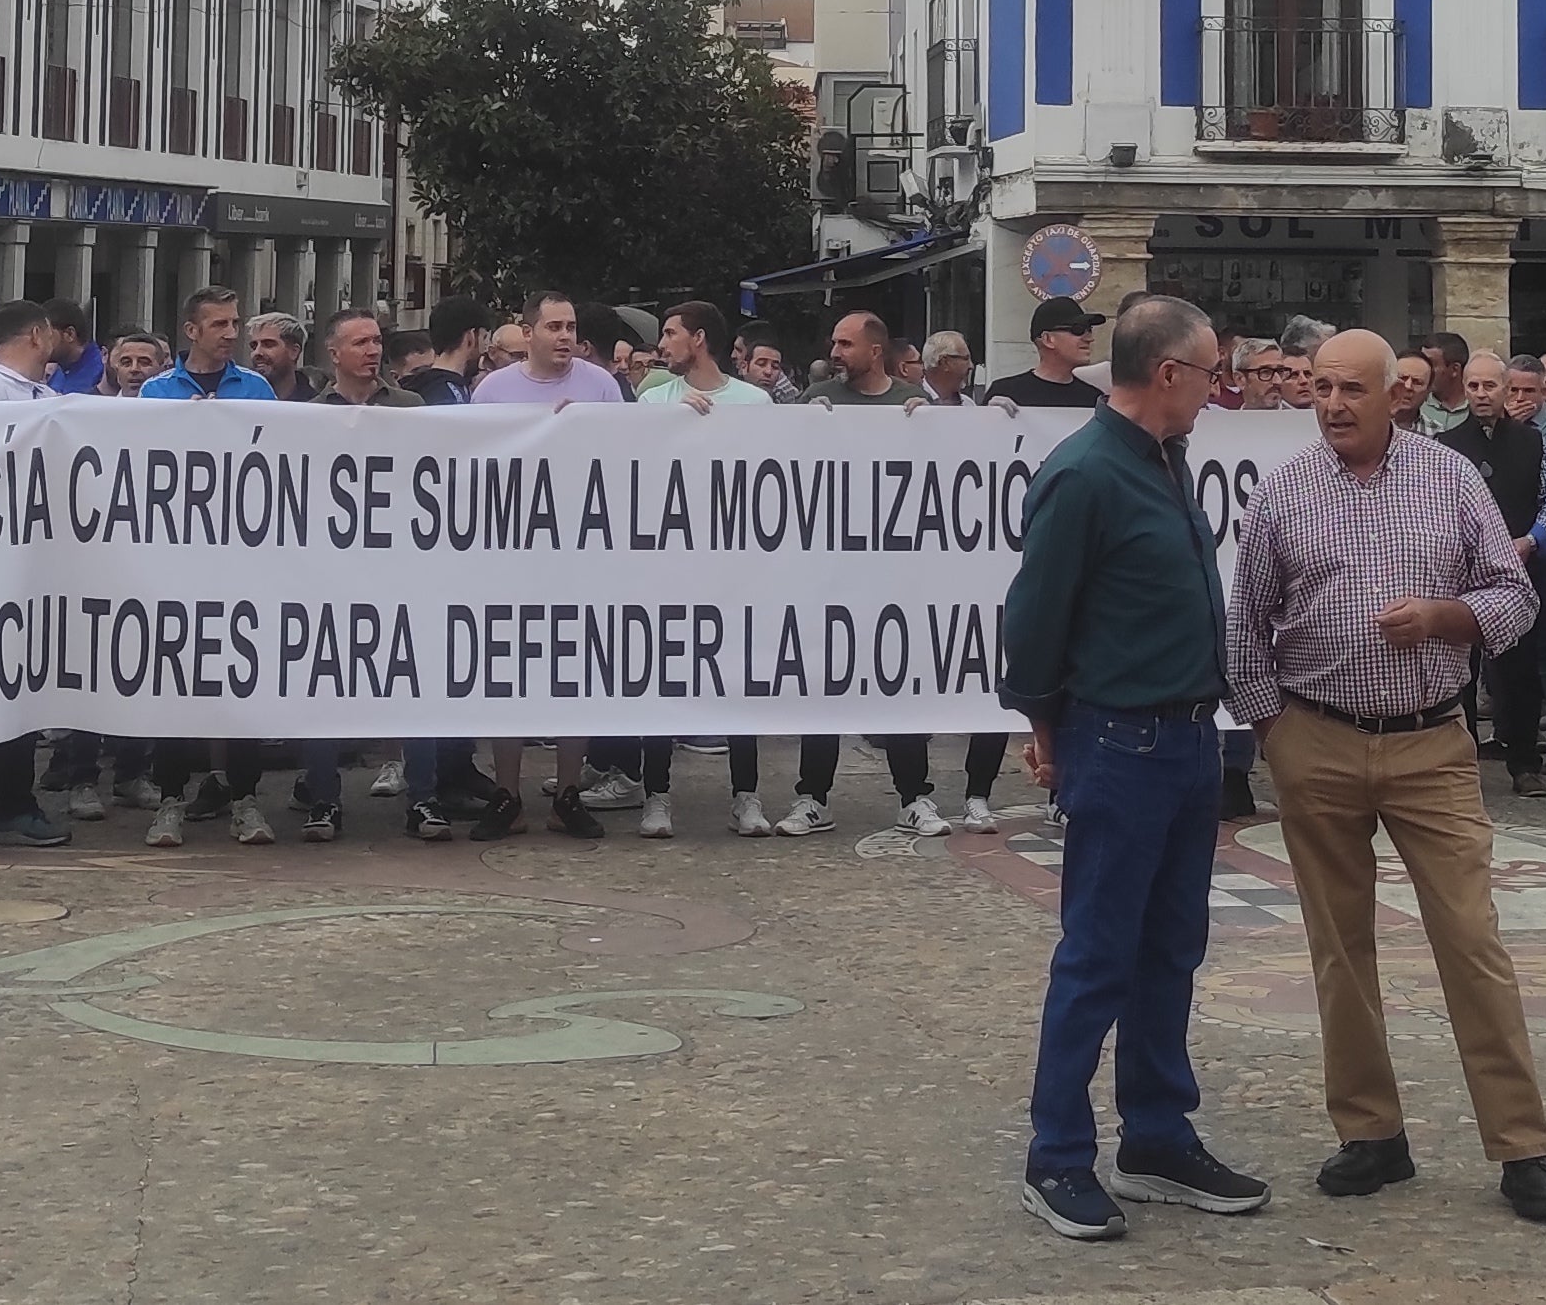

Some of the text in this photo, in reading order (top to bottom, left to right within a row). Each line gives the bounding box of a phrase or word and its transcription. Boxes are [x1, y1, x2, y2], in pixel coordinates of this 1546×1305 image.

[1021, 234, 1044, 276] EXCEPTO
[1066, 227, 1080, 239] DE
[1080, 236, 1101, 277] GUARDIA
[69, 426, 309, 548] CARRIÓN
[327, 453, 395, 551] SE
[410, 456, 562, 551] SUMA
[576, 458, 615, 551] A
[629, 458, 695, 552] LA
[709, 434, 1045, 553] MOVILIZACIÓ
[279, 602, 422, 699] PARA
[445, 603, 727, 699] DEFENDER
[743, 604, 810, 698] LA
